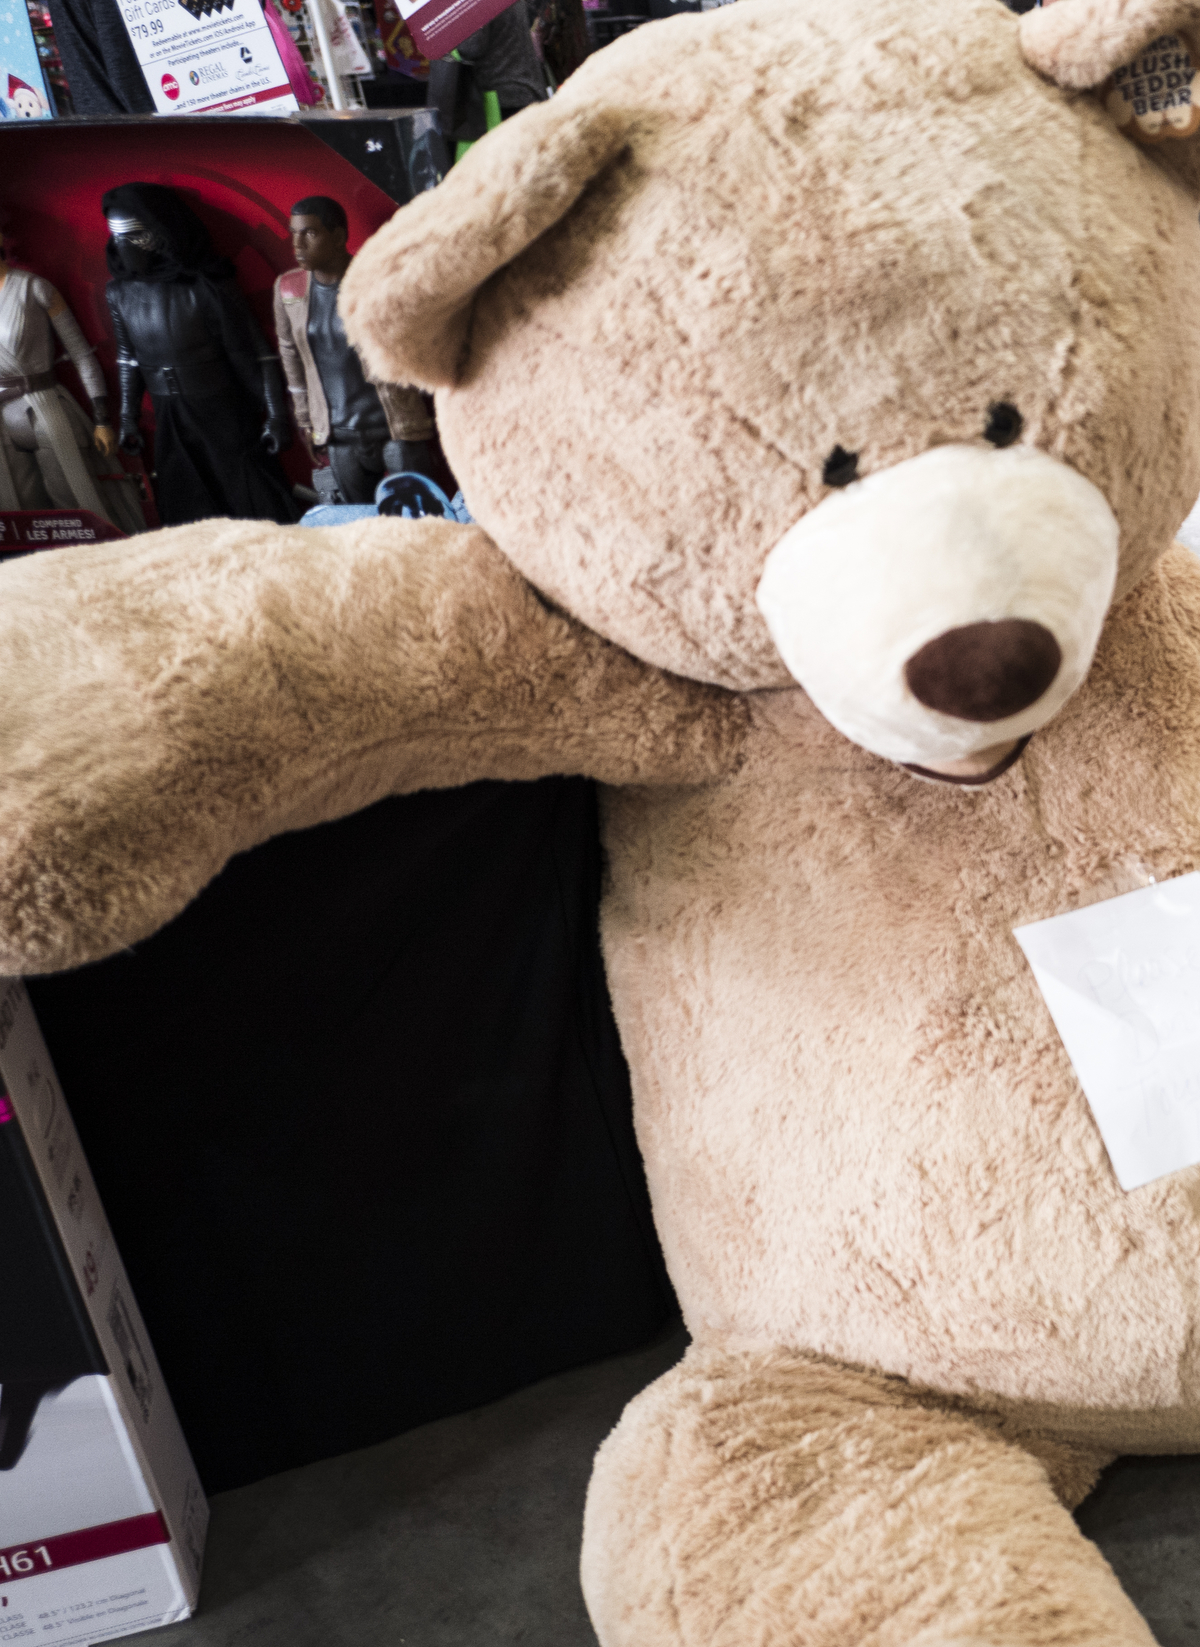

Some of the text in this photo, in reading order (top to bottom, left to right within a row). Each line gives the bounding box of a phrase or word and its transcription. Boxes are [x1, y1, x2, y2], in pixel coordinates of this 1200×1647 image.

[124, 7, 144, 22] Gift
[145, 0, 176, 16] Cards
[131, 19, 164, 39] $79.99
[152, 33, 182, 47] Redeemable
[188, 13, 244, 36] www.movietickets.com
[163, 47, 171, 55] the
[171, 34, 213, 51] MovieTickets.com
[245, 20, 256, 30] App
[168, 52, 200, 67] Participating
[200, 46, 221, 59] theaters
[198, 61, 227, 77] REGAL
[201, 70, 229, 85] CINEMAS
[1114, 52, 1190, 84] PLUSH
[162, 81, 179, 92] amc
[186, 98, 196, 108] 150
[196, 96, 209, 106] more
[209, 89, 229, 102] theater
[229, 84, 245, 96] chains
[251, 79, 260, 88] the
[1120, 67, 1197, 101] TEDDY
[1133, 88, 1192, 116] BEAR
[366, 140, 383, 153] 3+
[32, 519, 83, 529] COMPREND
[26, 528, 96, 541] LES ARMES!
[2, 1627, 36, 1641] CLASSE
